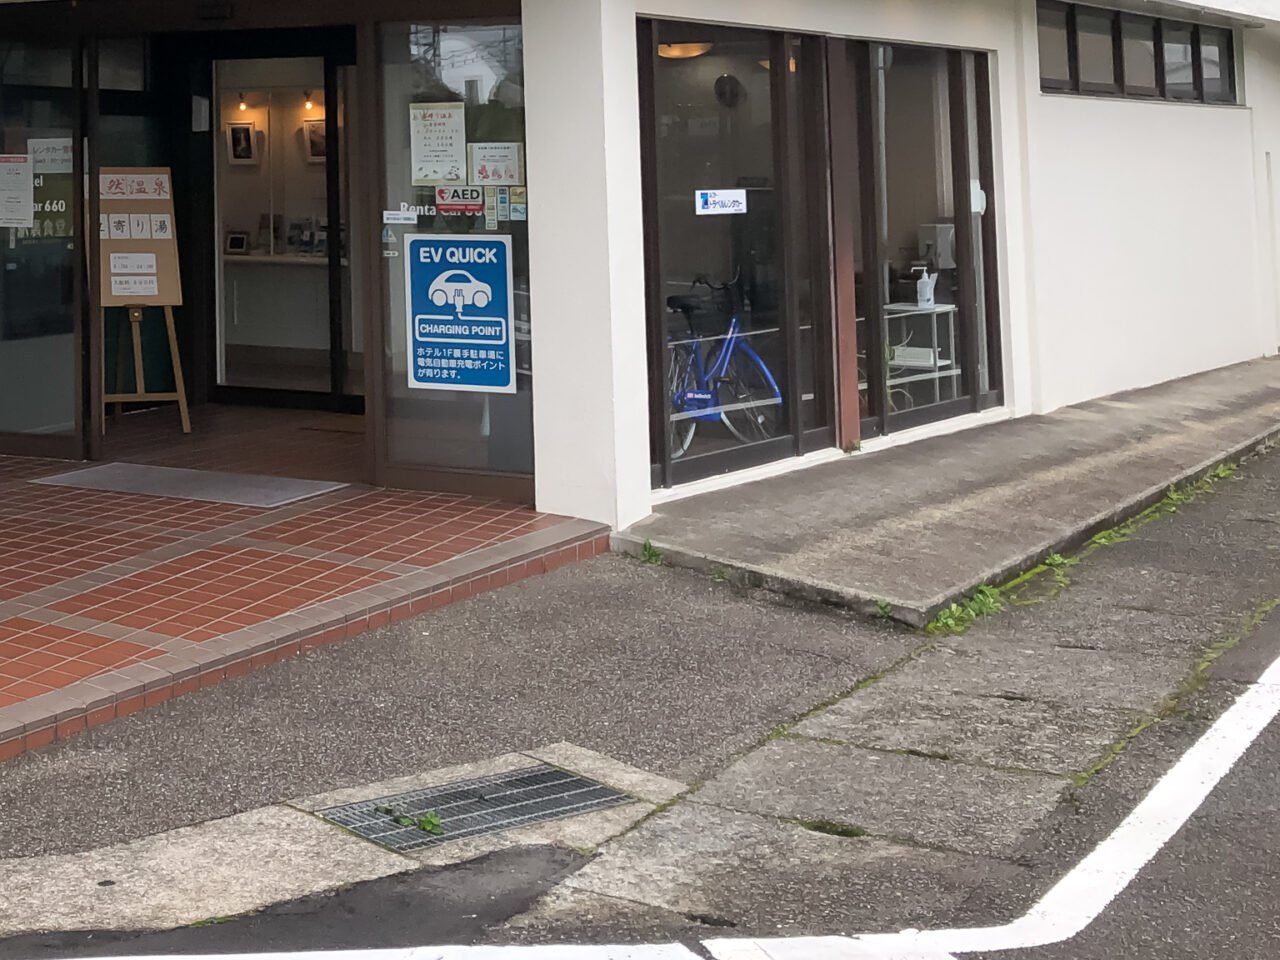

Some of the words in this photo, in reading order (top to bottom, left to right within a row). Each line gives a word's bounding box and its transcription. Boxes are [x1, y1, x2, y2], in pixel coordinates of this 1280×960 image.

[100, 178, 169, 196] 然温泉
[451, 189, 480, 200] AED
[44, 200, 66, 212] 660
[419, 247, 443, 263] EV
[446, 247, 497, 264] QUICK
[420, 324, 470, 335] CHARGING
[471, 326, 501, 336] POINT
[416, 357, 506, 370] 電気自動車充電ポイント
